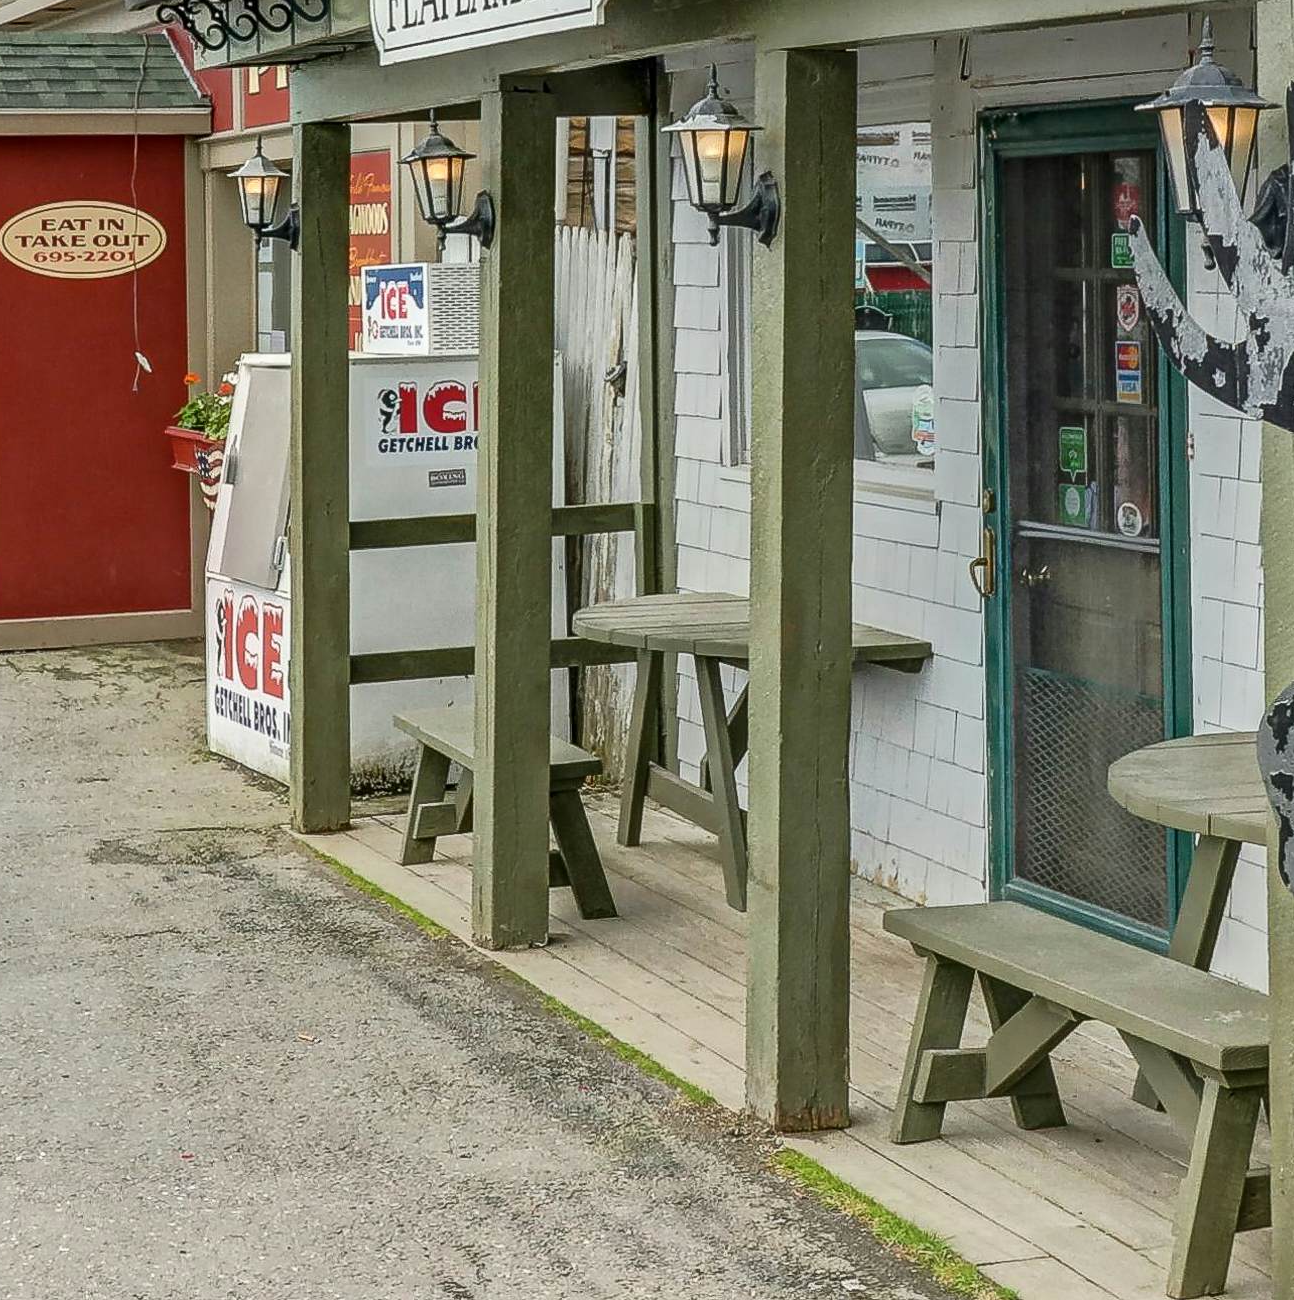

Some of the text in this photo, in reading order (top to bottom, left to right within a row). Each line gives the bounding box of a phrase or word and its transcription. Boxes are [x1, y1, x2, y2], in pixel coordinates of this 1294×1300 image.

[41, 218, 124, 231] EAT IN
[14, 234, 150, 248] TAKE OUT
[33, 250, 136, 263] 695-2201
[379, 280, 409, 320] ICE
[398, 380, 479, 434] IC
[378, 437, 449, 453] GETCHELL
[223, 588, 284, 700] ICE
[214, 685, 252, 729] GETCHELL
[254, 701, 280, 740] BROS.
